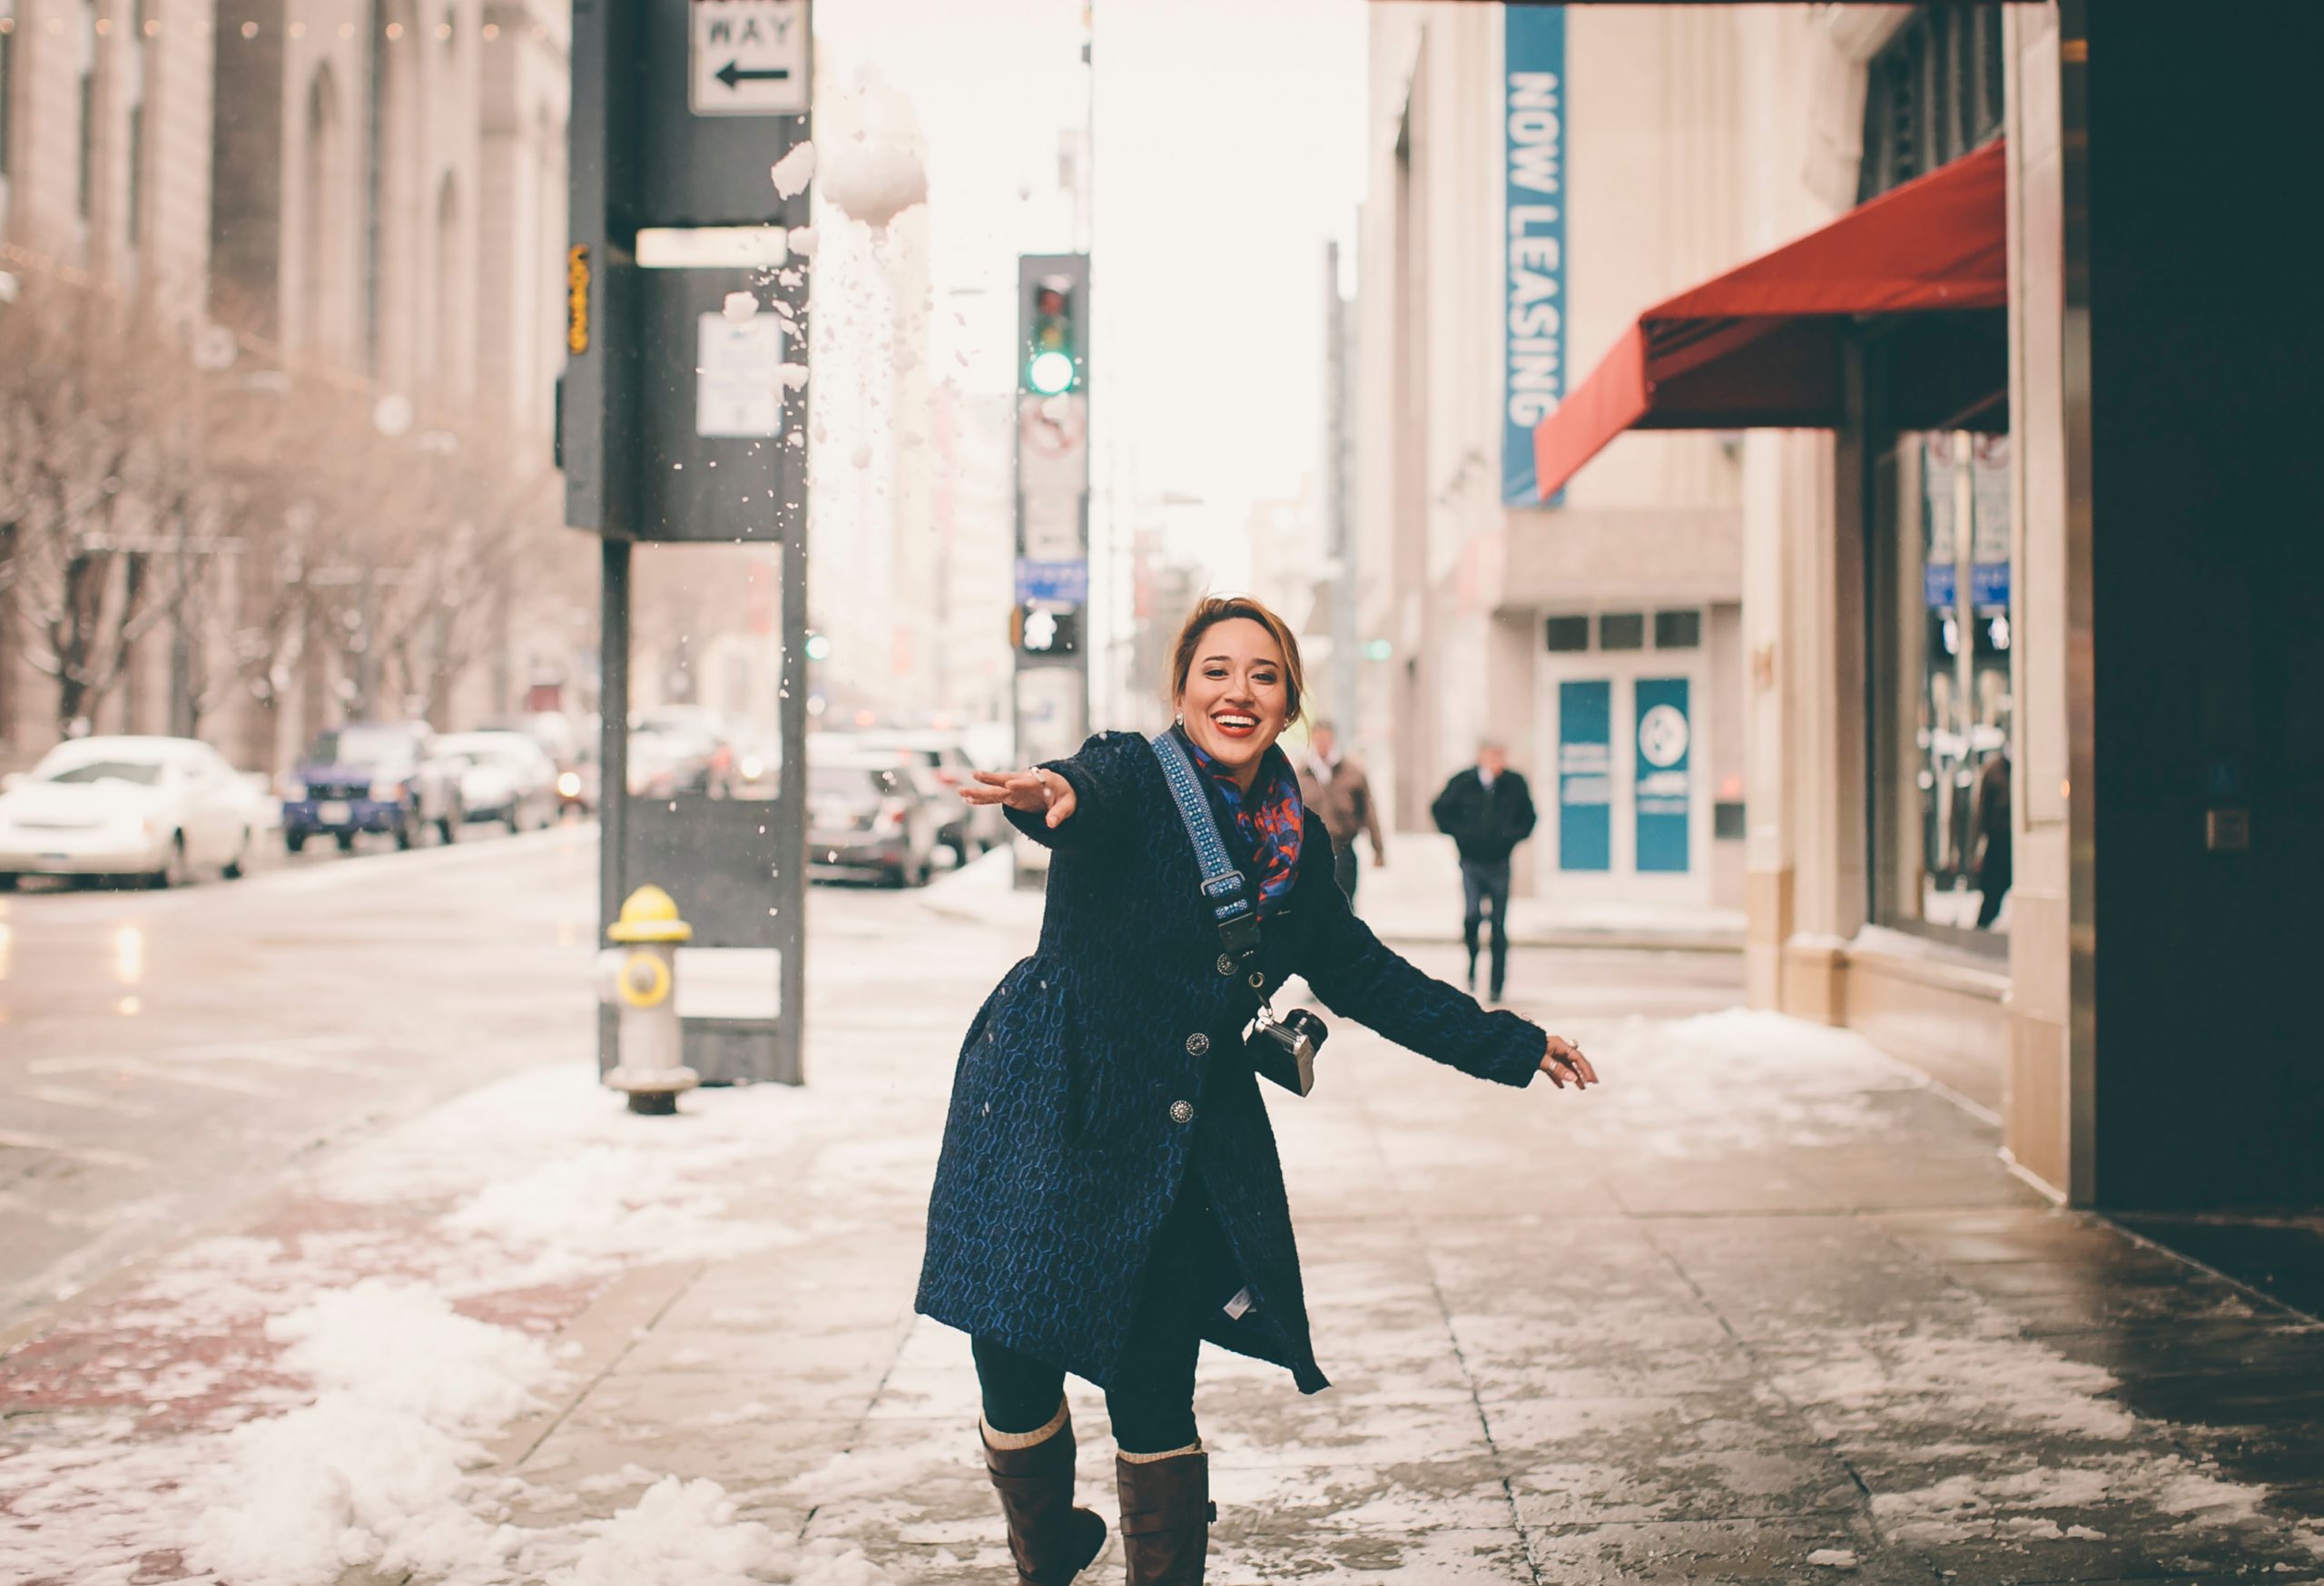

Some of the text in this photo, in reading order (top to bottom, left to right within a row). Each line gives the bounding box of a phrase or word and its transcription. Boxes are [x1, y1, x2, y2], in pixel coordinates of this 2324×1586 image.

[706, 15, 793, 44] WAY
[1509, 72, 1560, 428] NOW LEASING
